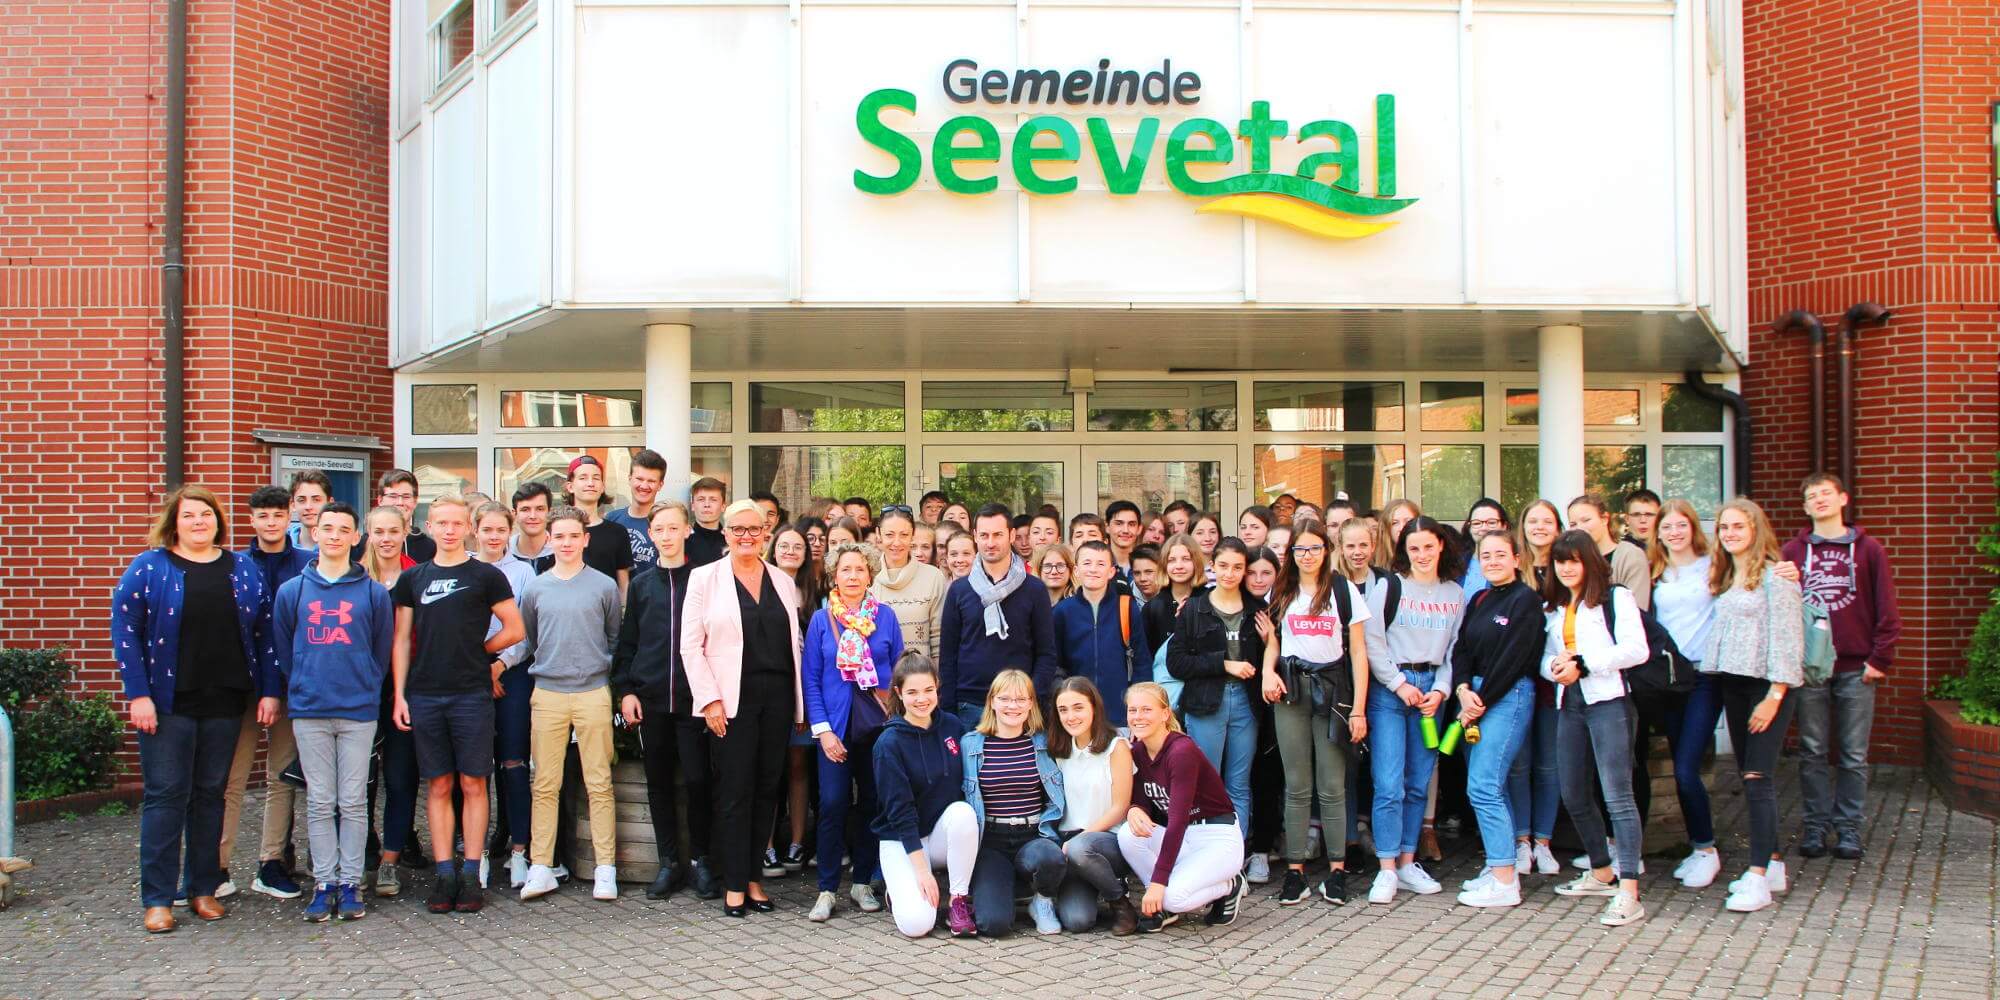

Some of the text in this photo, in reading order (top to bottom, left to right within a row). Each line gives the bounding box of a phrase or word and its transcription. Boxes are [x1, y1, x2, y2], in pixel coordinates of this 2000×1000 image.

[942, 58, 1201, 105] Gemeinde
[853, 88, 1396, 197] Seevetal
[427, 578, 458, 593] NIKE
[307, 626, 353, 645] UA
